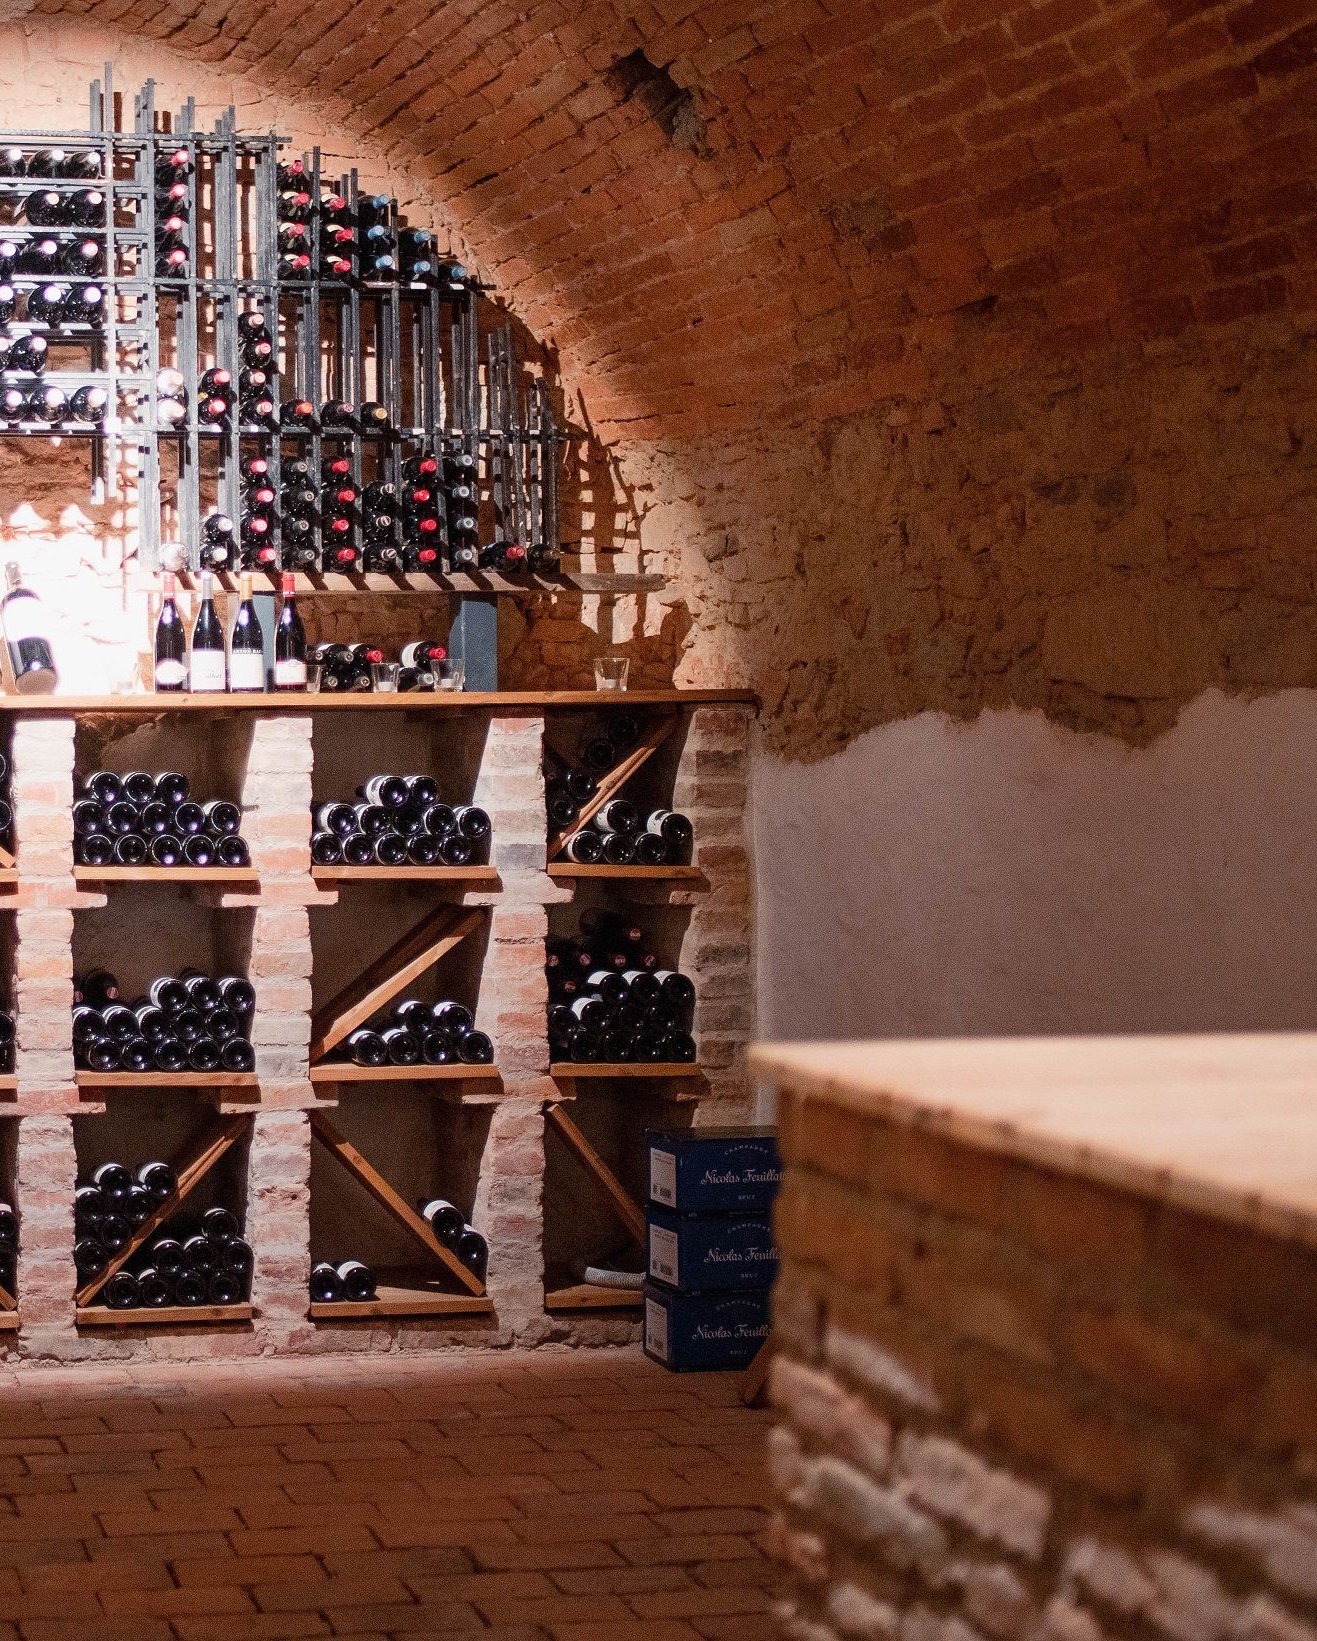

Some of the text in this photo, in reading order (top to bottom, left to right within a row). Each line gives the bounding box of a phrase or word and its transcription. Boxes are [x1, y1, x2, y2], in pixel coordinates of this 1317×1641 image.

[700, 1168, 784, 1185] Nicolas Feuillat
[704, 1247, 743, 1263] Nicolas
[691, 1324, 732, 1340] Nicolas
